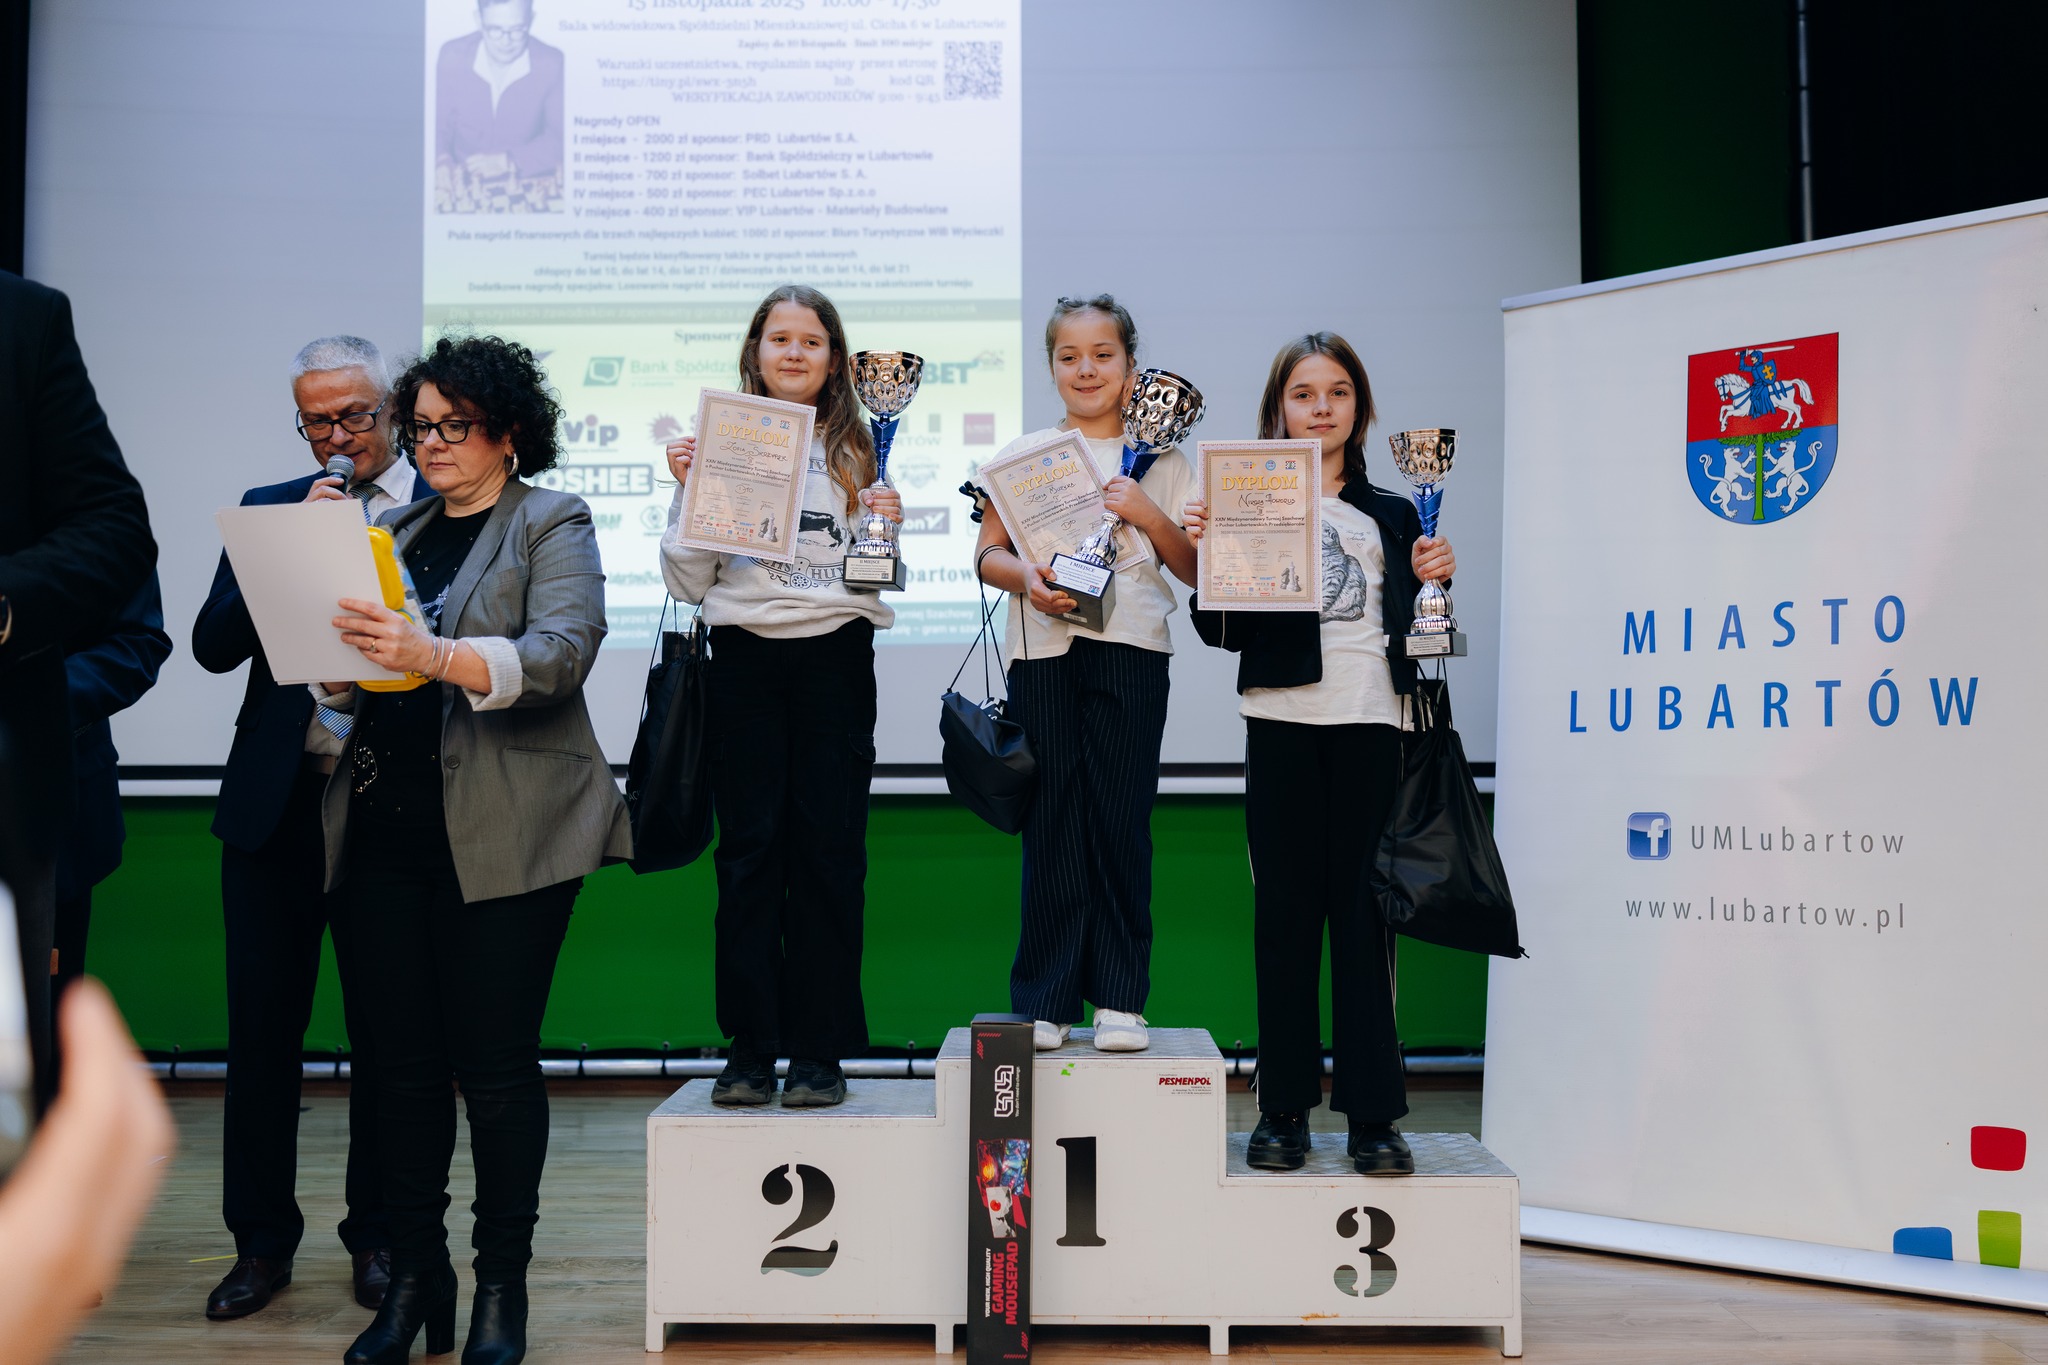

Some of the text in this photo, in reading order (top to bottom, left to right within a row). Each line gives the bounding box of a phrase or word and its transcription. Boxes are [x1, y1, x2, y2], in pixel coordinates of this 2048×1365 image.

[574, 115, 660, 128] Nagrody OPEN
[717, 422, 790, 448] DYPLOM
[1011, 461, 1080, 497] DYPLOM
[1222, 475, 1298, 491] DYPLOM
[1623, 595, 1906, 655] MIASTO
[1569, 668, 1979, 733] LUBARTÓW
[1690, 824, 1904, 854] UMLubartow
[1625, 897, 1905, 934] www.lubartow.pl
[761, 1163, 838, 1277] 2
[1055, 1136, 1107, 1248] 1
[1333, 1206, 1398, 1298] 3
[992, 1252, 1005, 1314] GAMING
[1005, 1241, 1019, 1326] MOUSEPAD
